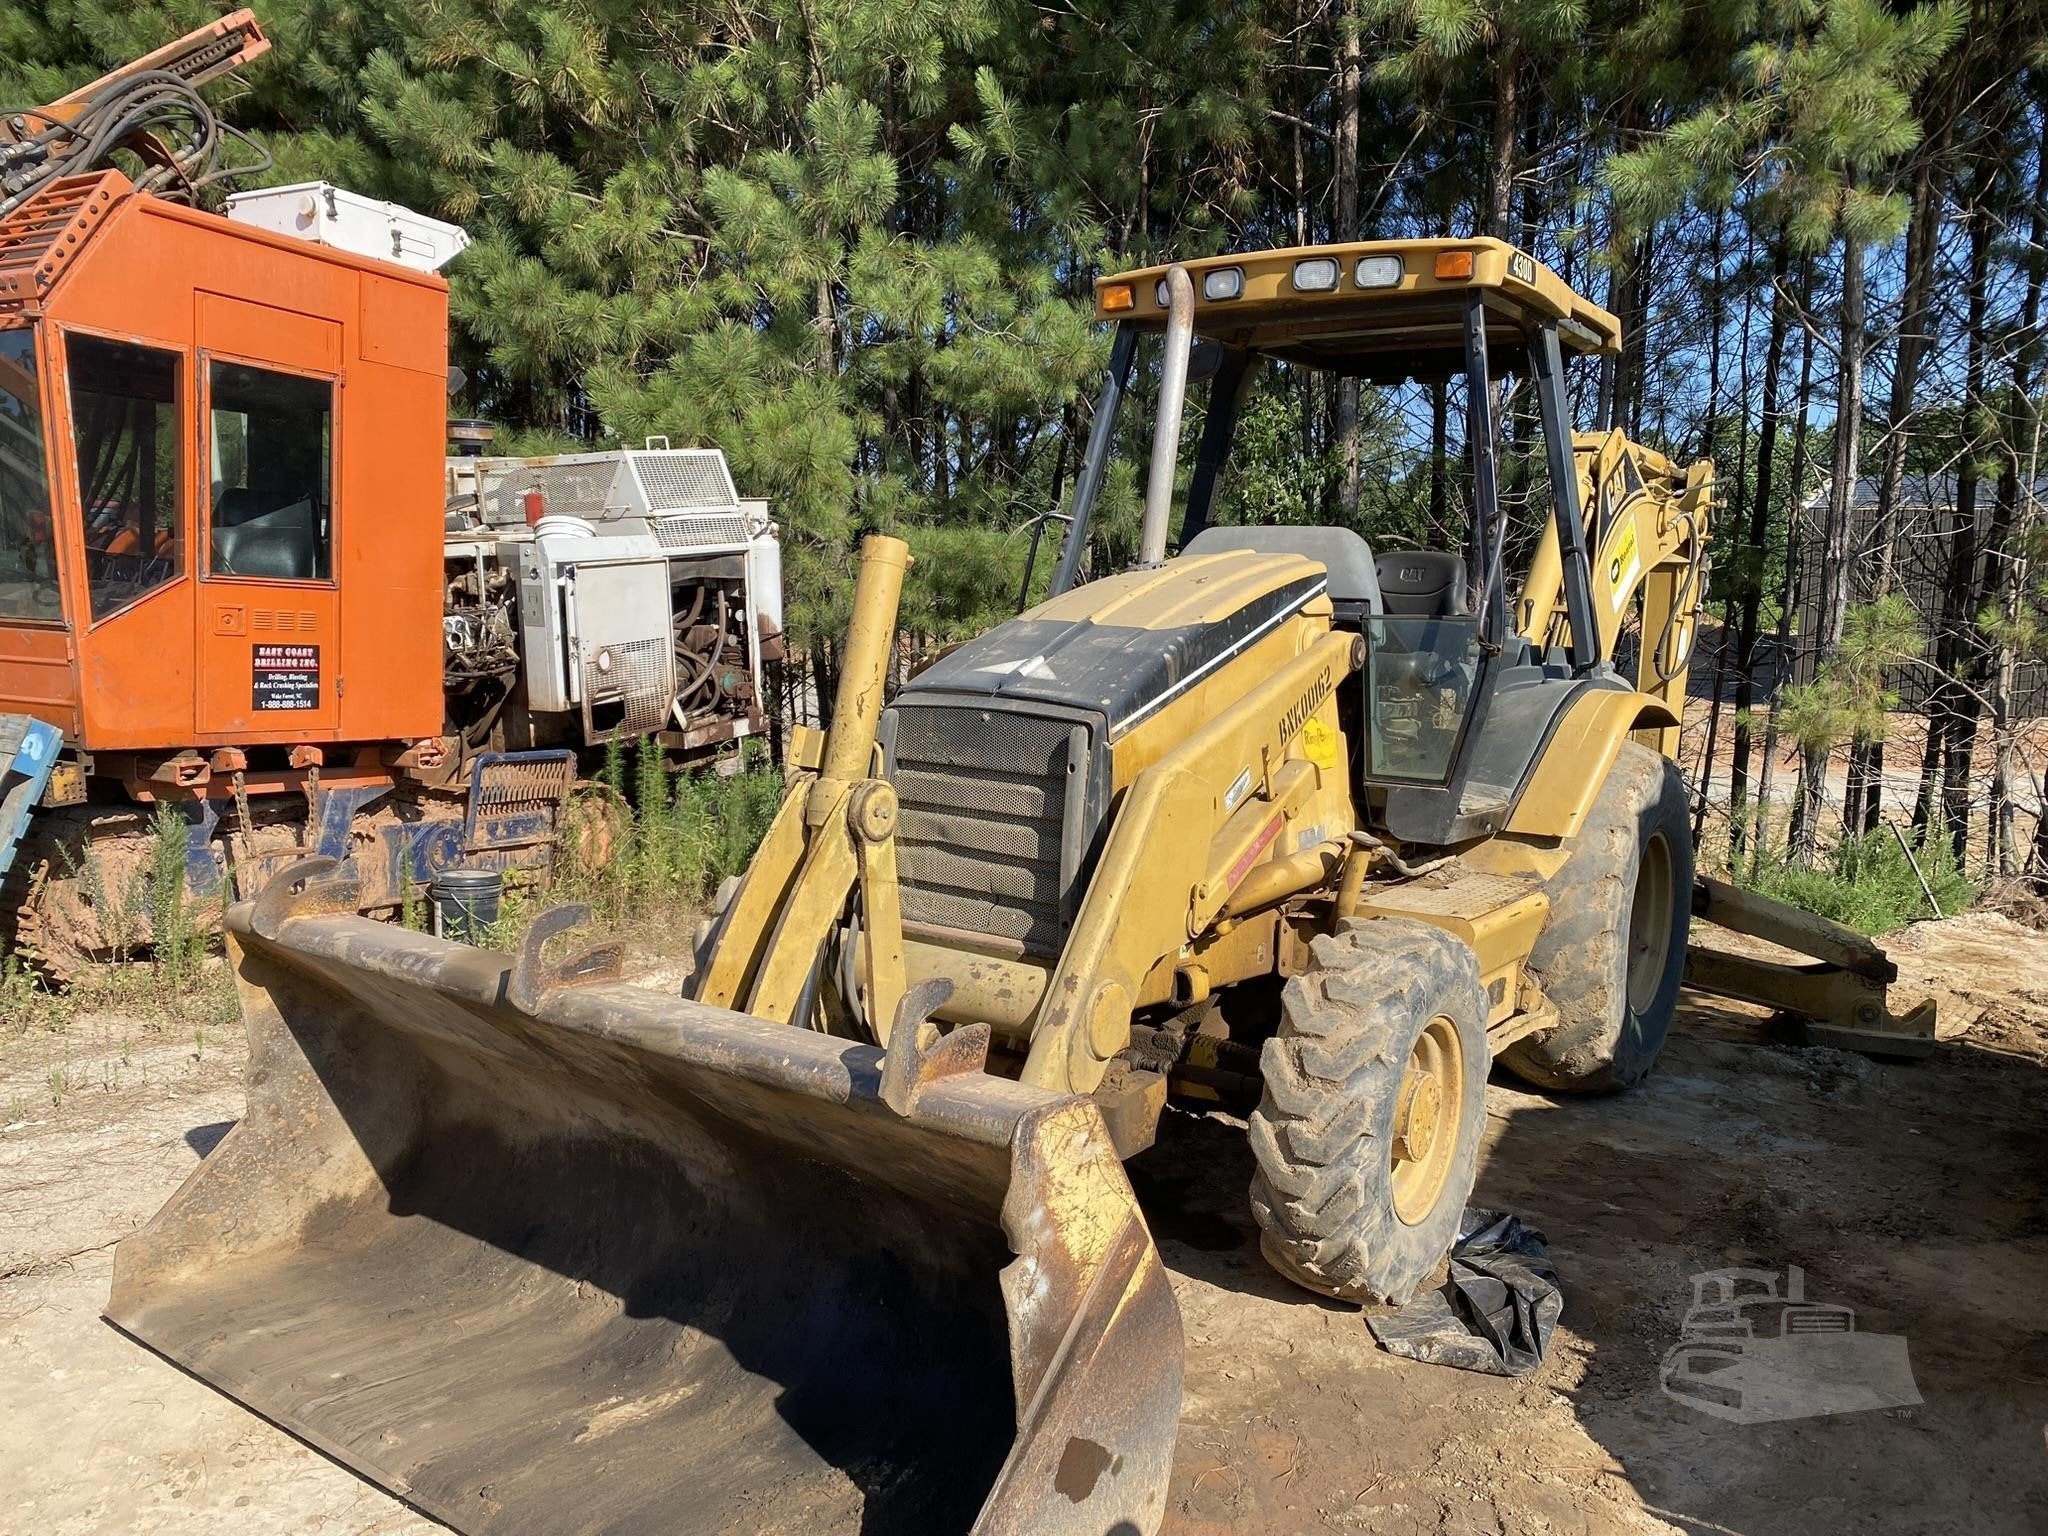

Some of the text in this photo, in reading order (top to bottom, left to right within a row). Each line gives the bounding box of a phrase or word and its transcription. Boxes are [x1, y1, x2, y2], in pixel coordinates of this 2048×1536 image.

[1513, 254, 1533, 282] 430D
[1606, 457, 1626, 516] CAT
[1400, 568, 1425, 582] CAT
[254, 658, 318, 668] DRILLING INC.
[259, 648, 313, 657] EAST COAST
[1279, 665, 1332, 746] BNK00162
